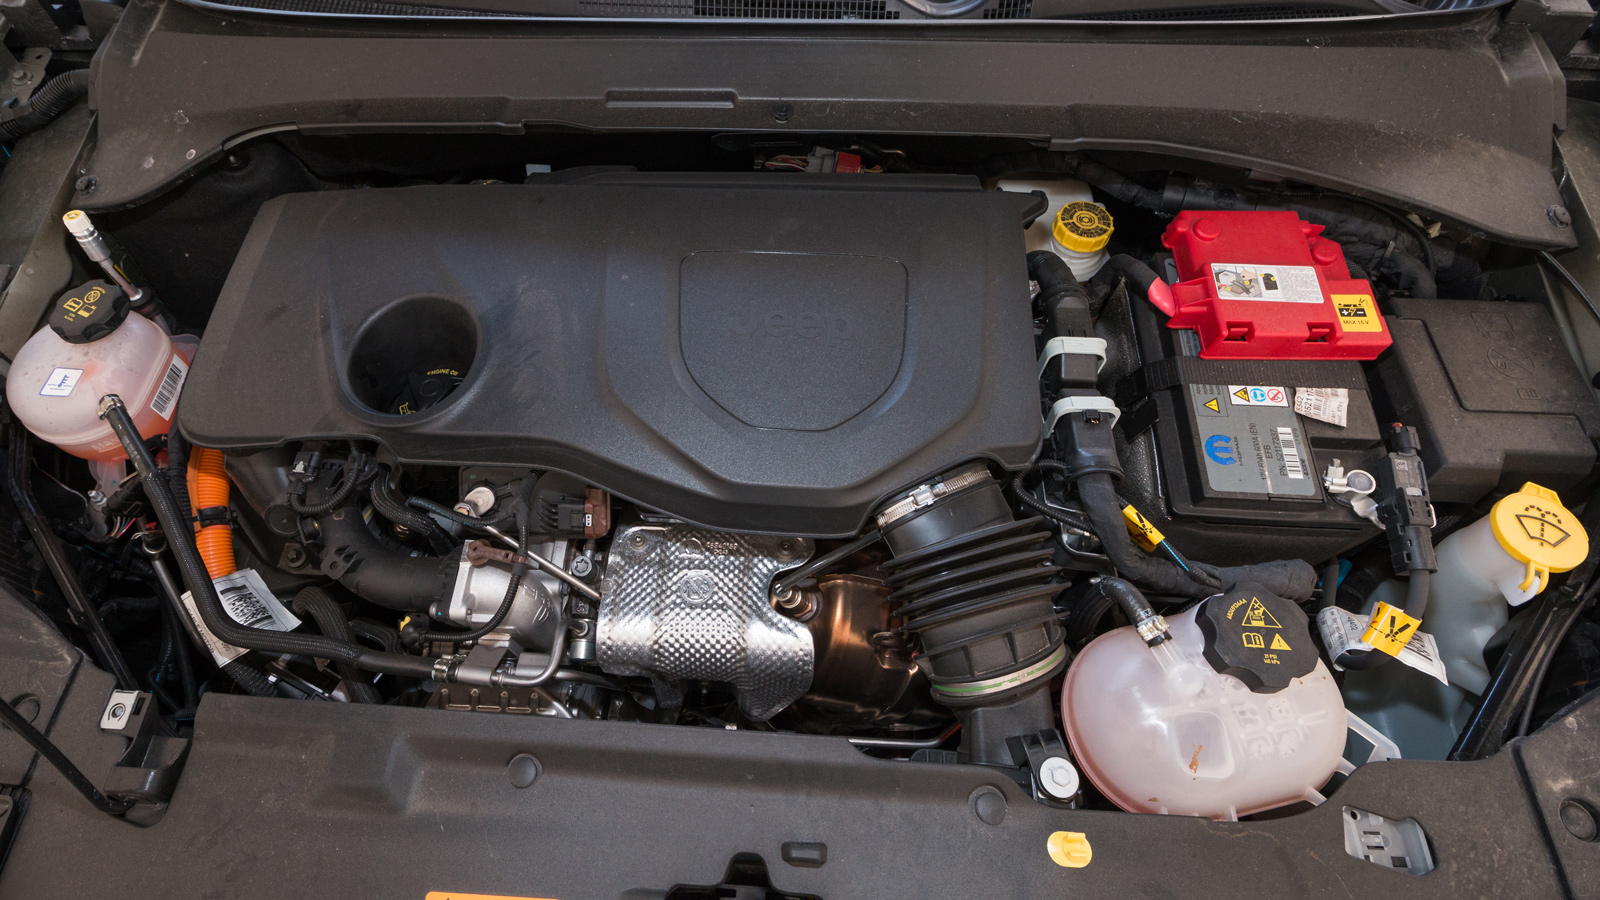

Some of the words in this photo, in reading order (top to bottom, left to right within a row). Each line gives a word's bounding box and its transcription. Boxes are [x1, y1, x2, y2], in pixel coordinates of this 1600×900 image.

[728, 300, 856, 348] Jeep
[427, 368, 450, 376] ENGINE
[1233, 436, 1244, 466] MOPAR
[1263, 444, 1273, 459] EFB
[1270, 429, 1285, 462] 52117337
[1279, 462, 1288, 476] PN:
